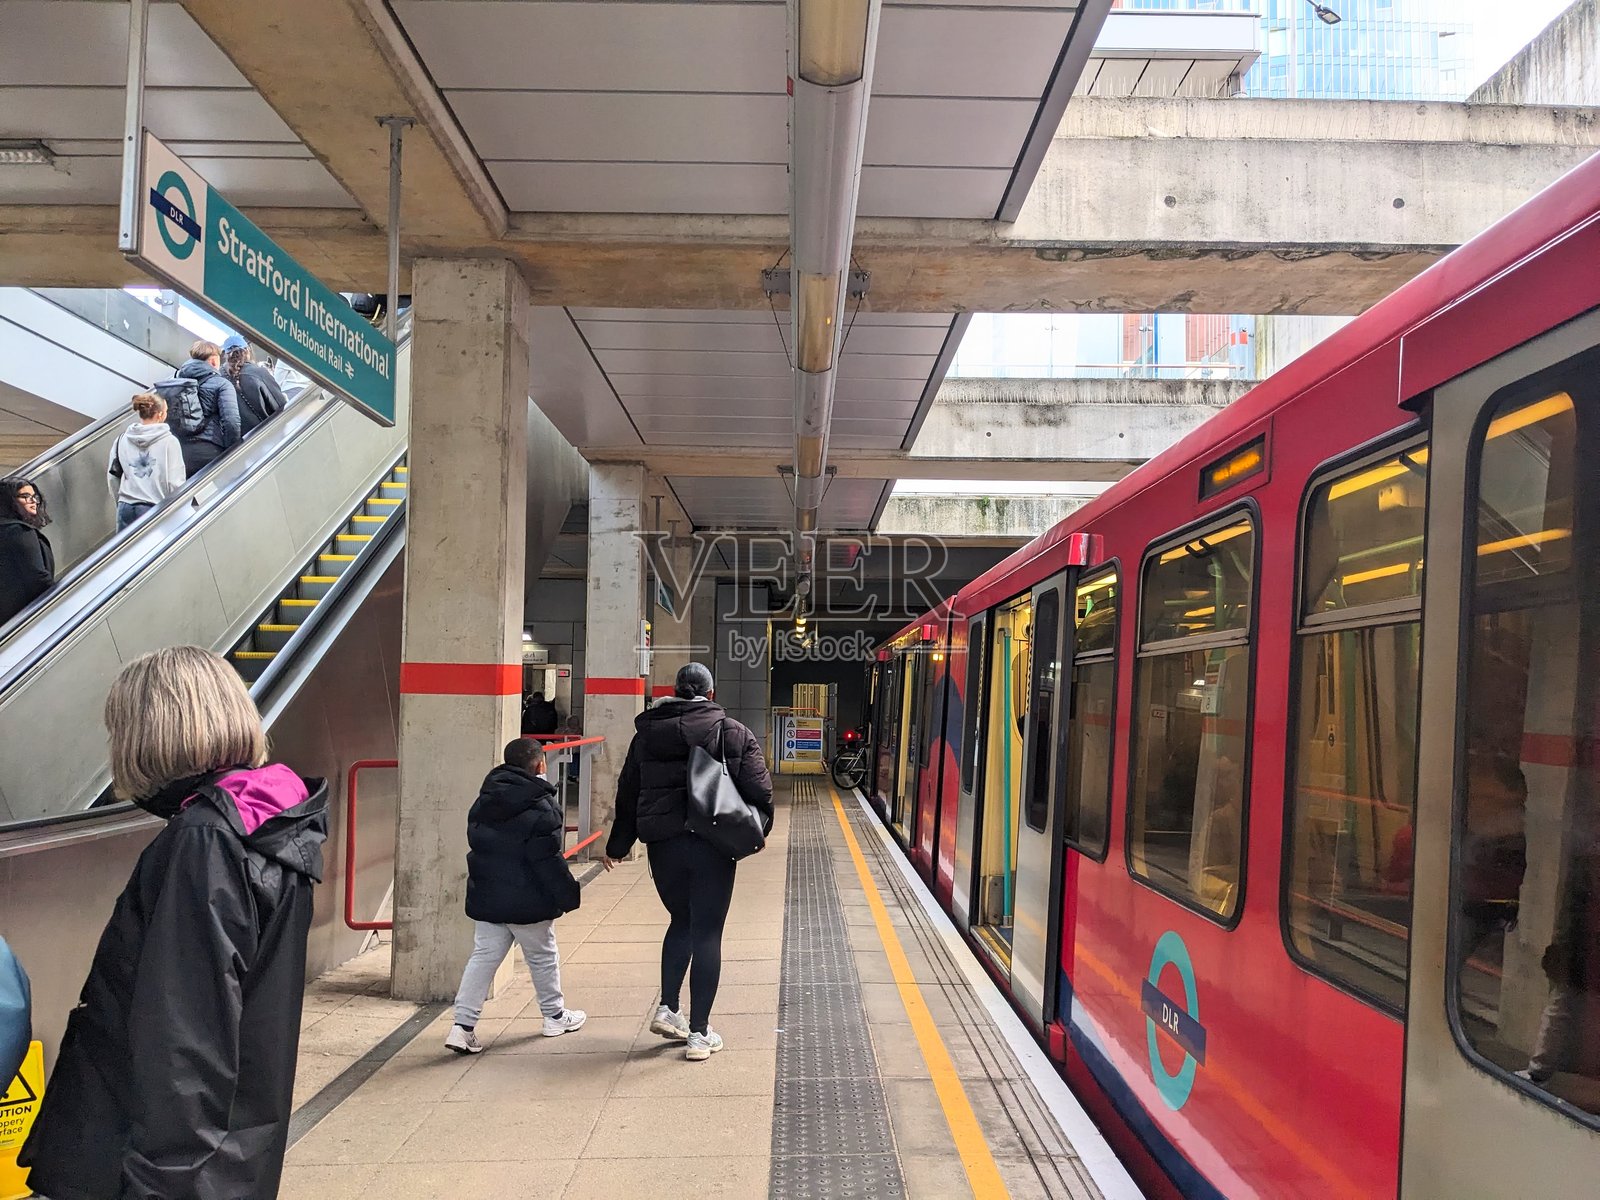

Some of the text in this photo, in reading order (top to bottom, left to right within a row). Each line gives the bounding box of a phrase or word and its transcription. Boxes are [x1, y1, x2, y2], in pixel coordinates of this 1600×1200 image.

[170, 206, 184, 225] DLR
[217, 217, 390, 380] Stratford International
[272, 307, 343, 373] for National Rail
[1162, 1003, 1178, 1034] DLR
